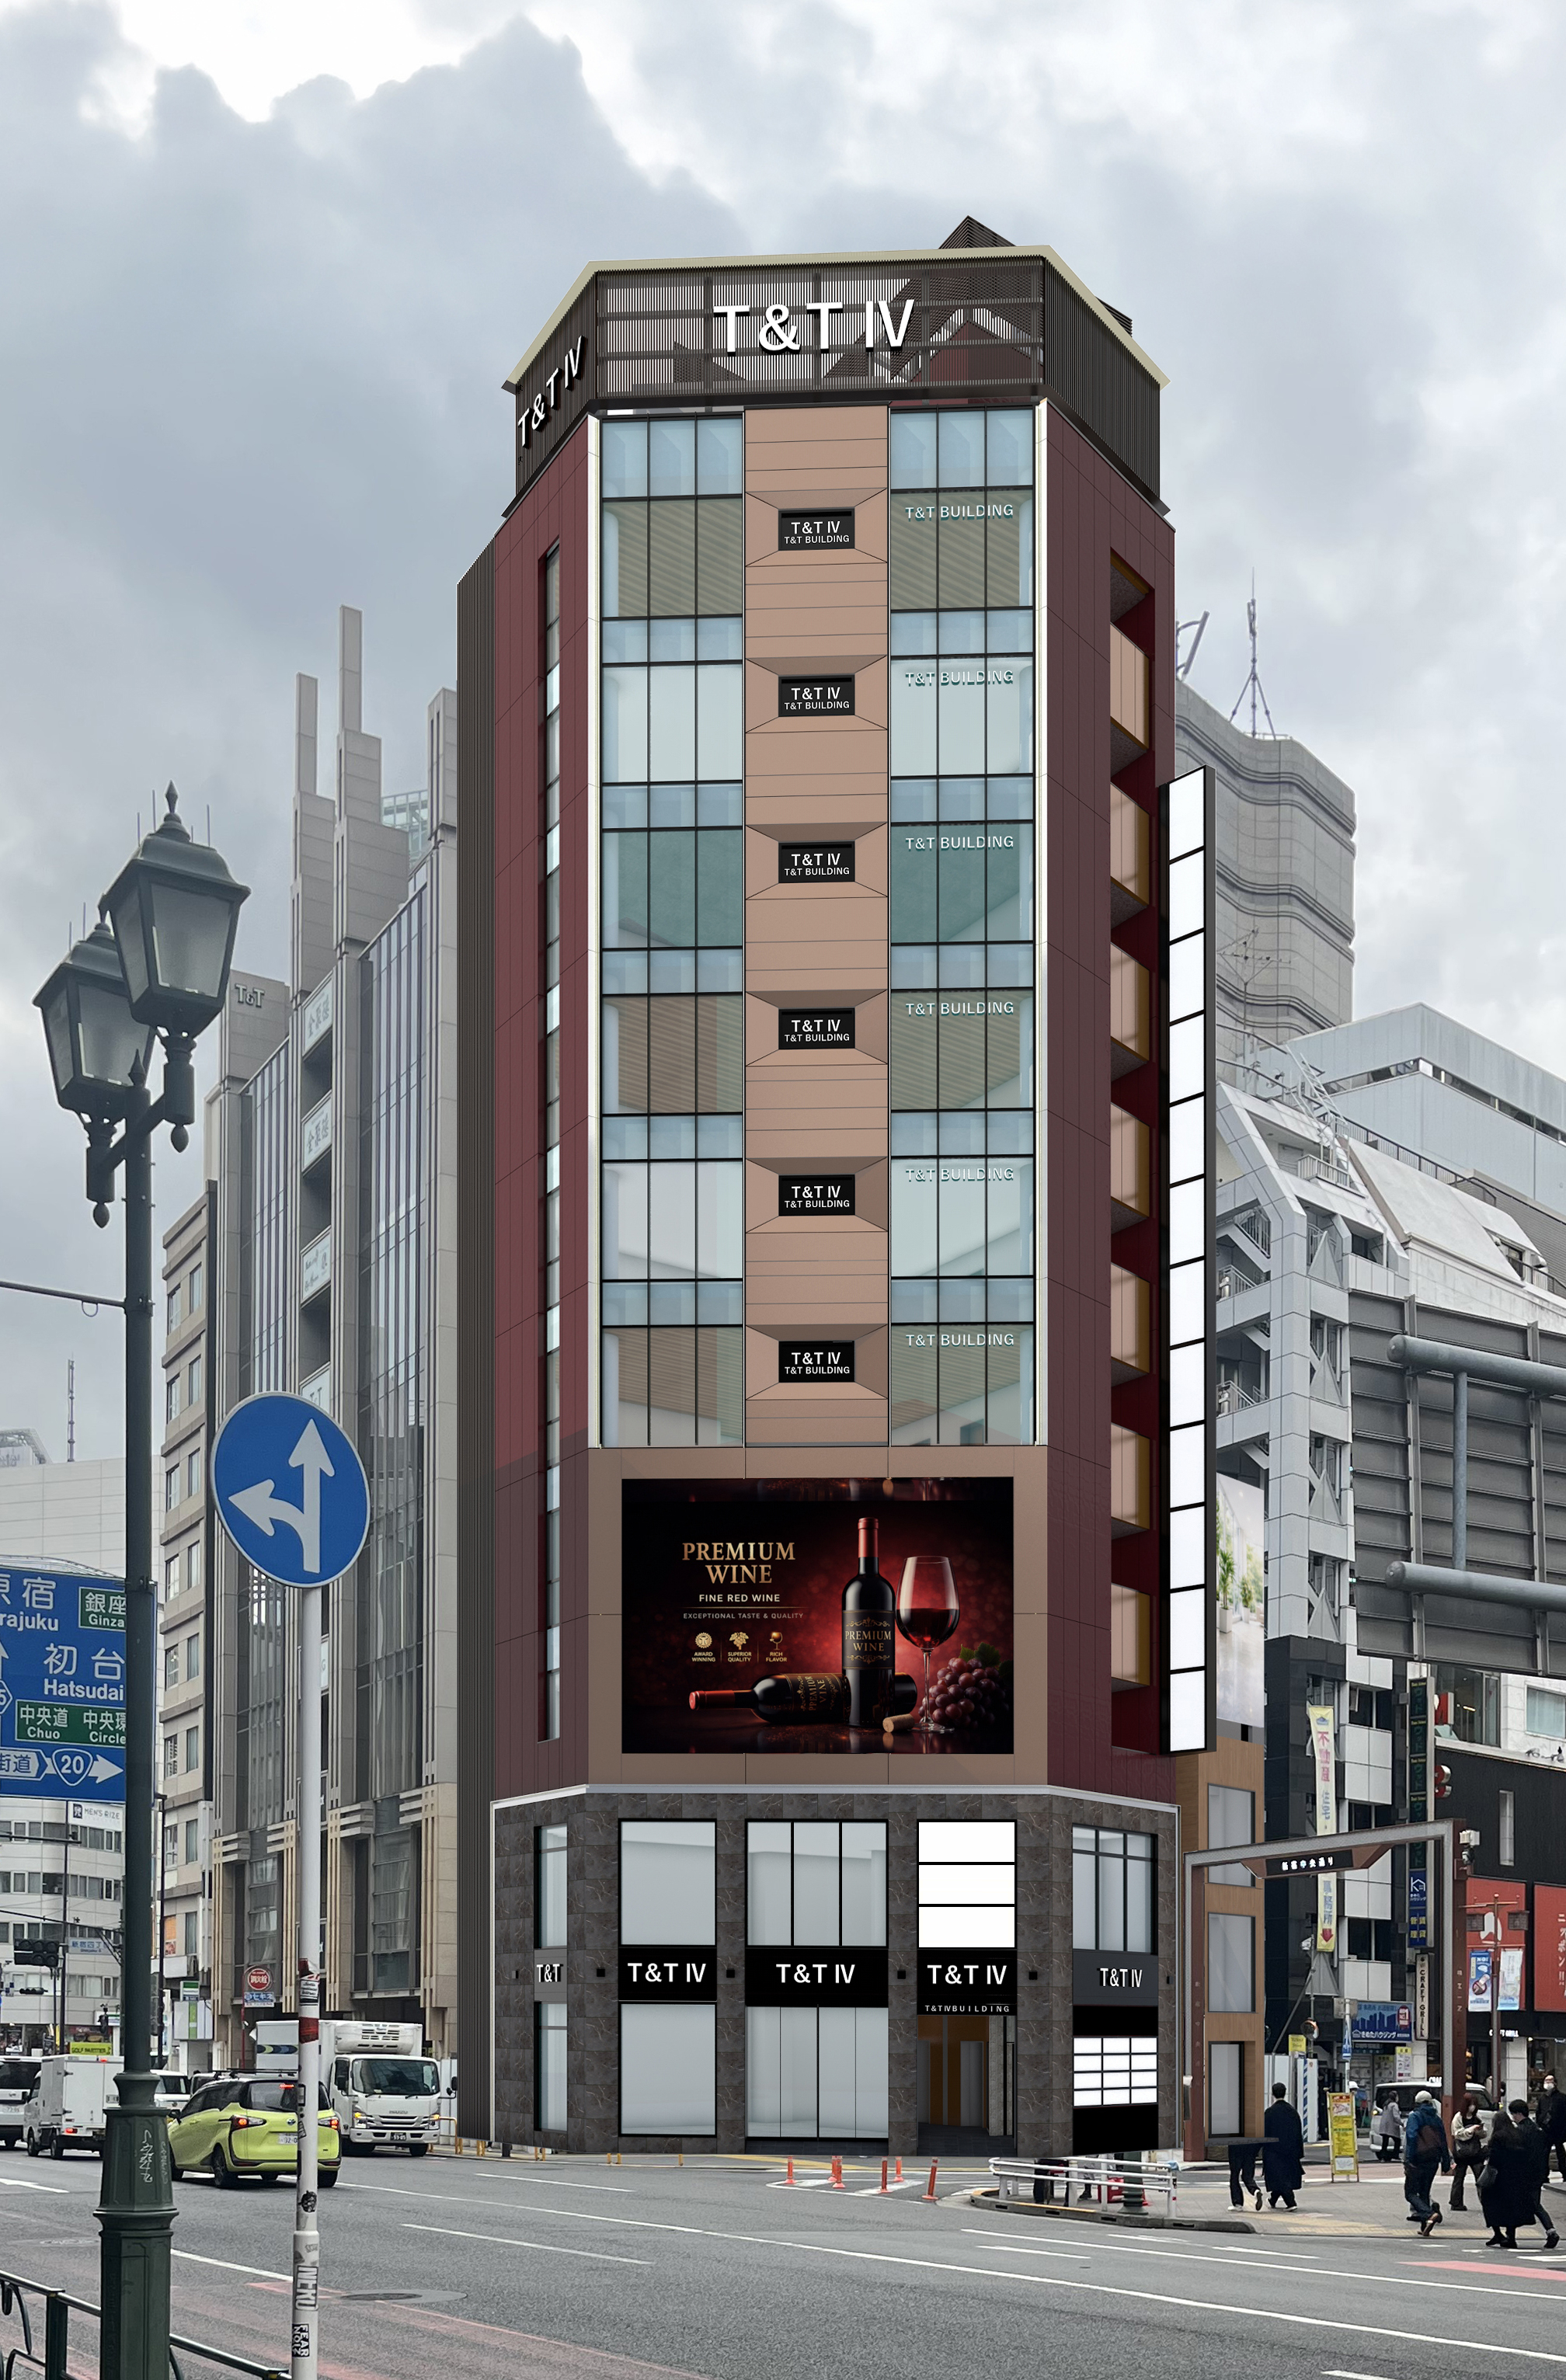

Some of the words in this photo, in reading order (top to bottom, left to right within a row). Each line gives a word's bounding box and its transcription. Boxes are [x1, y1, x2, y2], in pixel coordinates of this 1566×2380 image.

[713, 301, 844, 352] T&T
[865, 300, 915, 348] IV
[517, 367, 559, 447] T&T
[906, 505, 935, 518] T&T
[941, 504, 1014, 517] BUILDING
[791, 521, 823, 534] T&T
[784, 536, 803, 545] T&T
[805, 534, 850, 544] BUILDING
[906, 670, 935, 684] T&T
[941, 670, 1014, 683] BUILDING
[791, 687, 823, 701] T&T
[784, 702, 803, 711] T&T
[805, 701, 850, 710] BUILDING
[906, 837, 935, 850] T&T
[941, 836, 1014, 849] BUILDING
[791, 854, 823, 867] T&T
[784, 868, 803, 876] T&T
[805, 866, 850, 875] BUILDING
[235, 983, 266, 1009] T&T
[906, 1002, 935, 1015] T&T
[941, 1001, 1014, 1014] BUILDING
[791, 1020, 823, 1033] T&T
[784, 1034, 803, 1042] T&T
[805, 1032, 850, 1042] BUILDING
[906, 1168, 935, 1181] T&T
[941, 1167, 1014, 1181] BUILDING
[791, 1186, 823, 1199] T&T
[784, 1200, 803, 1209] T&T
[805, 1199, 850, 1208] BUILDING
[906, 1334, 935, 1348] T&T
[941, 1334, 1014, 1347] BUILDING
[791, 1352, 823, 1366] T&T
[784, 1367, 803, 1376] T&T
[805, 1366, 850, 1375] BUILDING
[682, 1542, 795, 1561] PREMIUM
[705, 1564, 772, 1584] WINE
[85, 1592, 126, 1615] 銀座
[699, 1594, 723, 1602] FINE
[727, 1594, 748, 1602] RED
[752, 1594, 780, 1602] WINE
[89, 1614, 125, 1627] Ginza
[844, 1630, 891, 1640] PREMIUM
[853, 1642, 885, 1651] WINE
[44, 1643, 125, 1680] 初台
[44, 1679, 124, 1701] Hatsudai
[20, 1704, 68, 1728] 中央道
[27, 1727, 61, 1739] Chuo
[61, 1755, 84, 1775] 20
[536, 1963, 560, 1983] T&T
[627, 1962, 679, 1982] T&T
[775, 1964, 828, 1983] T&T
[927, 1964, 980, 1985] T&T
[1100, 1968, 1129, 1988] T&T
[300, 2324, 309, 2357] FEAR
